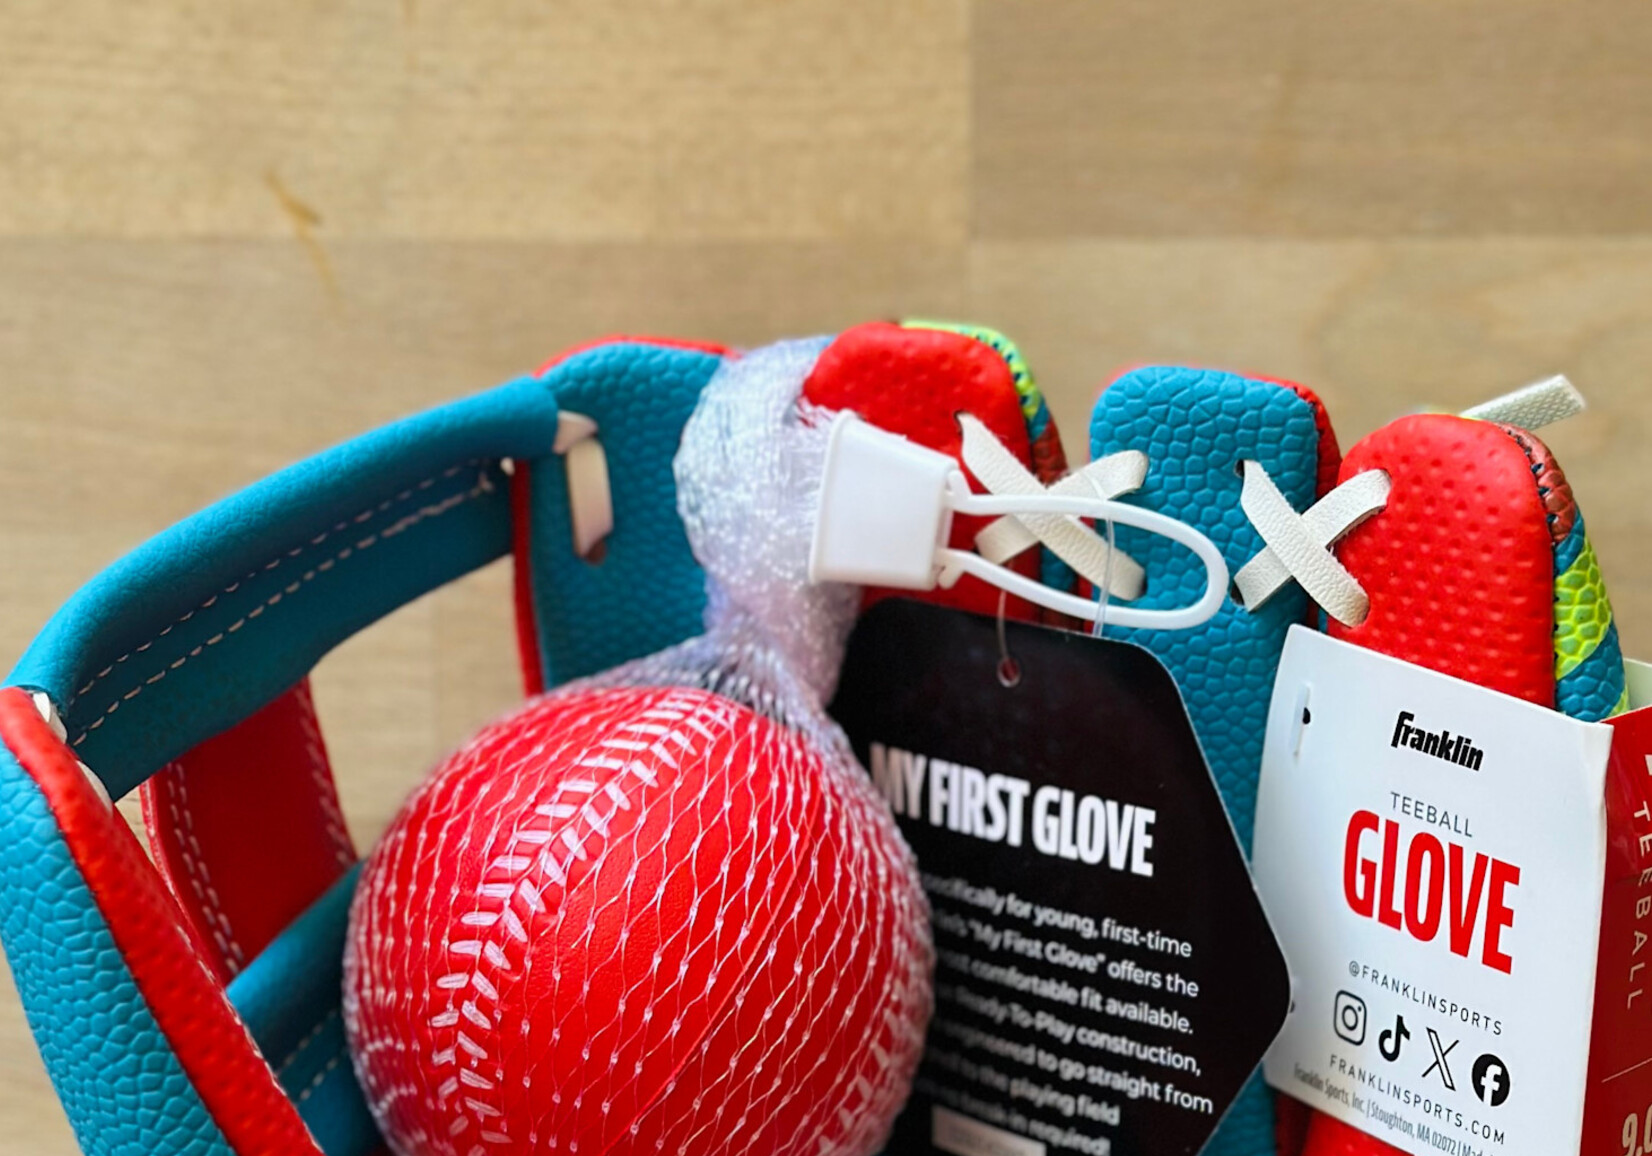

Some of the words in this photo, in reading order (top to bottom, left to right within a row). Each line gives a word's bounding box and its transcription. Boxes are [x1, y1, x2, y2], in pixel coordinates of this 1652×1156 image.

[1391, 710, 1484, 771] Franklin
[870, 742, 927, 819] MY
[929, 757, 1030, 847] FIRST
[1032, 784, 1156, 877] GLOVE
[1390, 792, 1473, 838] TEEBALL
[1006, 892, 1033, 918] for
[1034, 905, 1099, 938] young,
[1102, 917, 1193, 958] first-time
[1343, 809, 1521, 975] GLOVE
[971, 959, 1079, 1006] comfortable
[1081, 986, 1103, 1013] fit
[1105, 997, 1194, 1034] available.
[1108, 960, 1162, 989] offers
[1166, 974, 1200, 998] the
[1348, 960, 1503, 1036] @FRANKLINSPORTS
[1037, 1049, 1059, 1072] to
[1059, 1057, 1087, 1081] go
[1087, 1064, 1161, 1101] straight
[1165, 1083, 1214, 1115] from
[1076, 1027, 1202, 1077] construction,
[1330, 1054, 1506, 1145] FRANKLINSPORTS.COM
[1371, 1103, 1415, 1139] Stoughton,
[1416, 1124, 1431, 1145] MA
[1432, 1131, 1456, 1156] 02072
